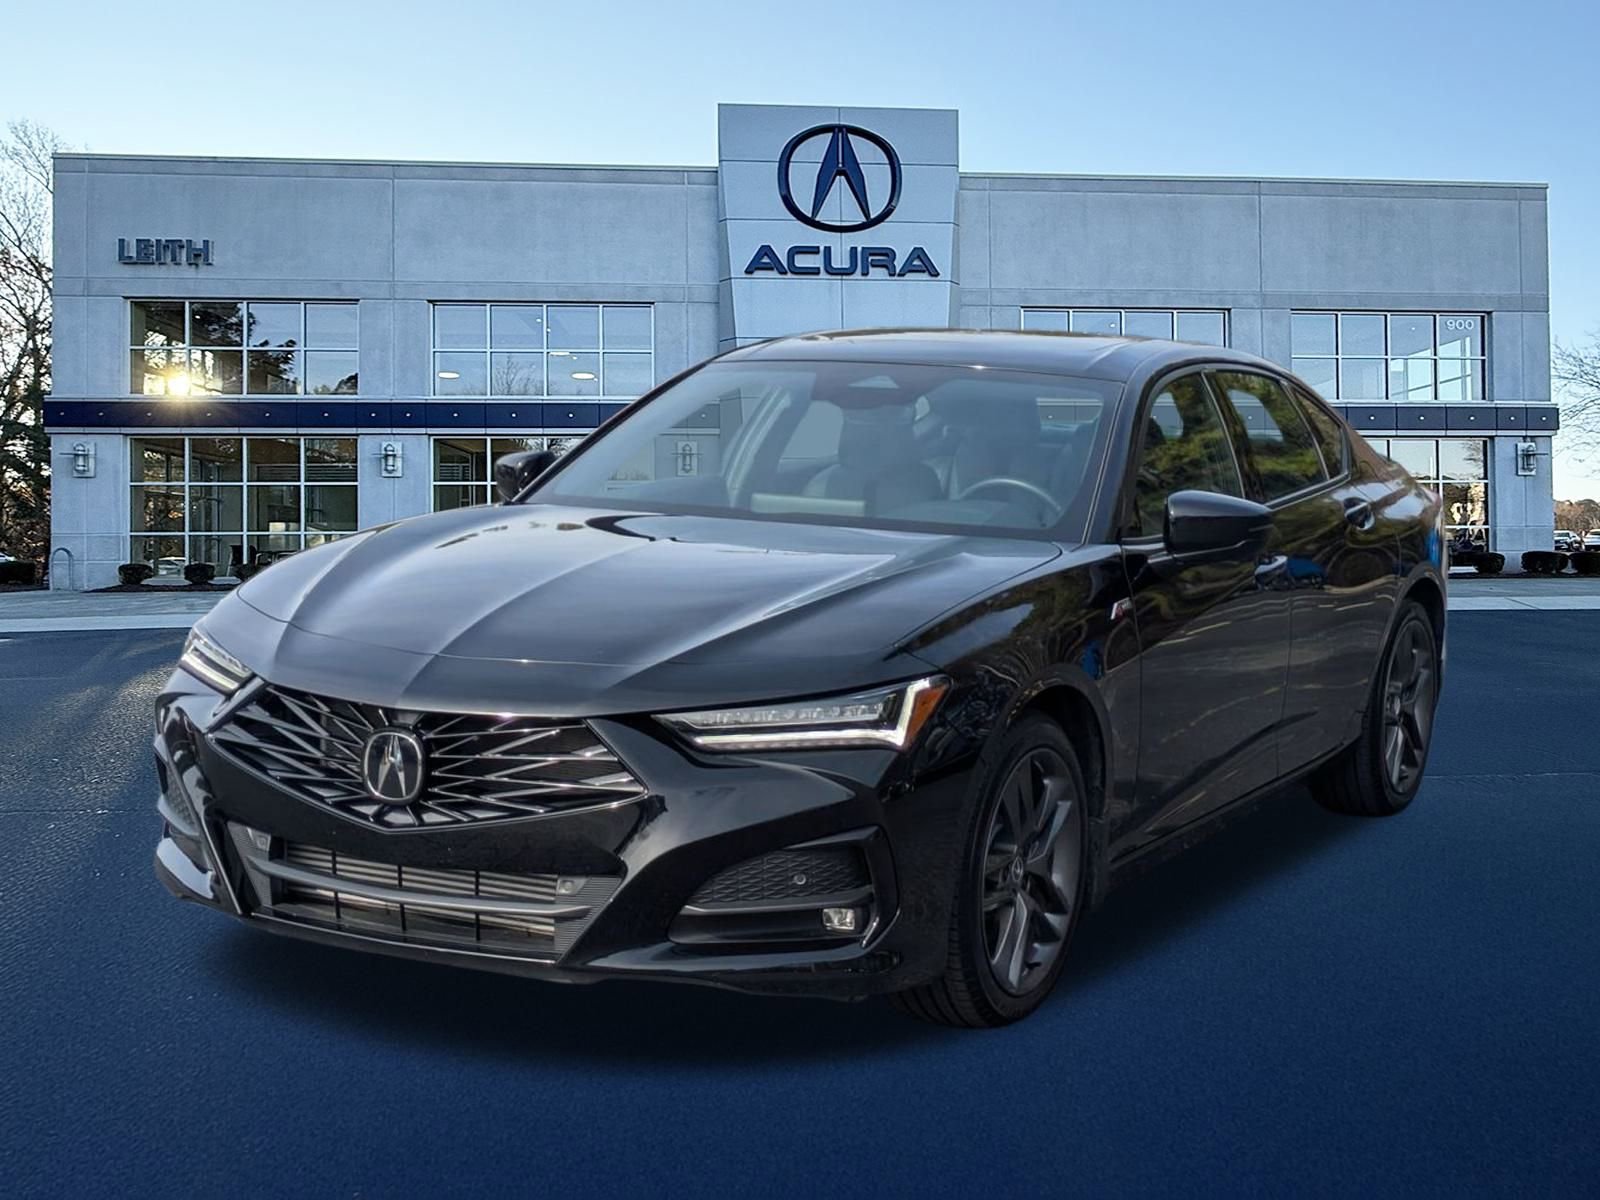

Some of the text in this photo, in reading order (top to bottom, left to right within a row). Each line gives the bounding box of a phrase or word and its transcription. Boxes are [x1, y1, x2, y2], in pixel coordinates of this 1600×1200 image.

[118, 238, 212, 265] LEITH
[744, 244, 940, 277] ACURA
[1446, 319, 1474, 330] 900
